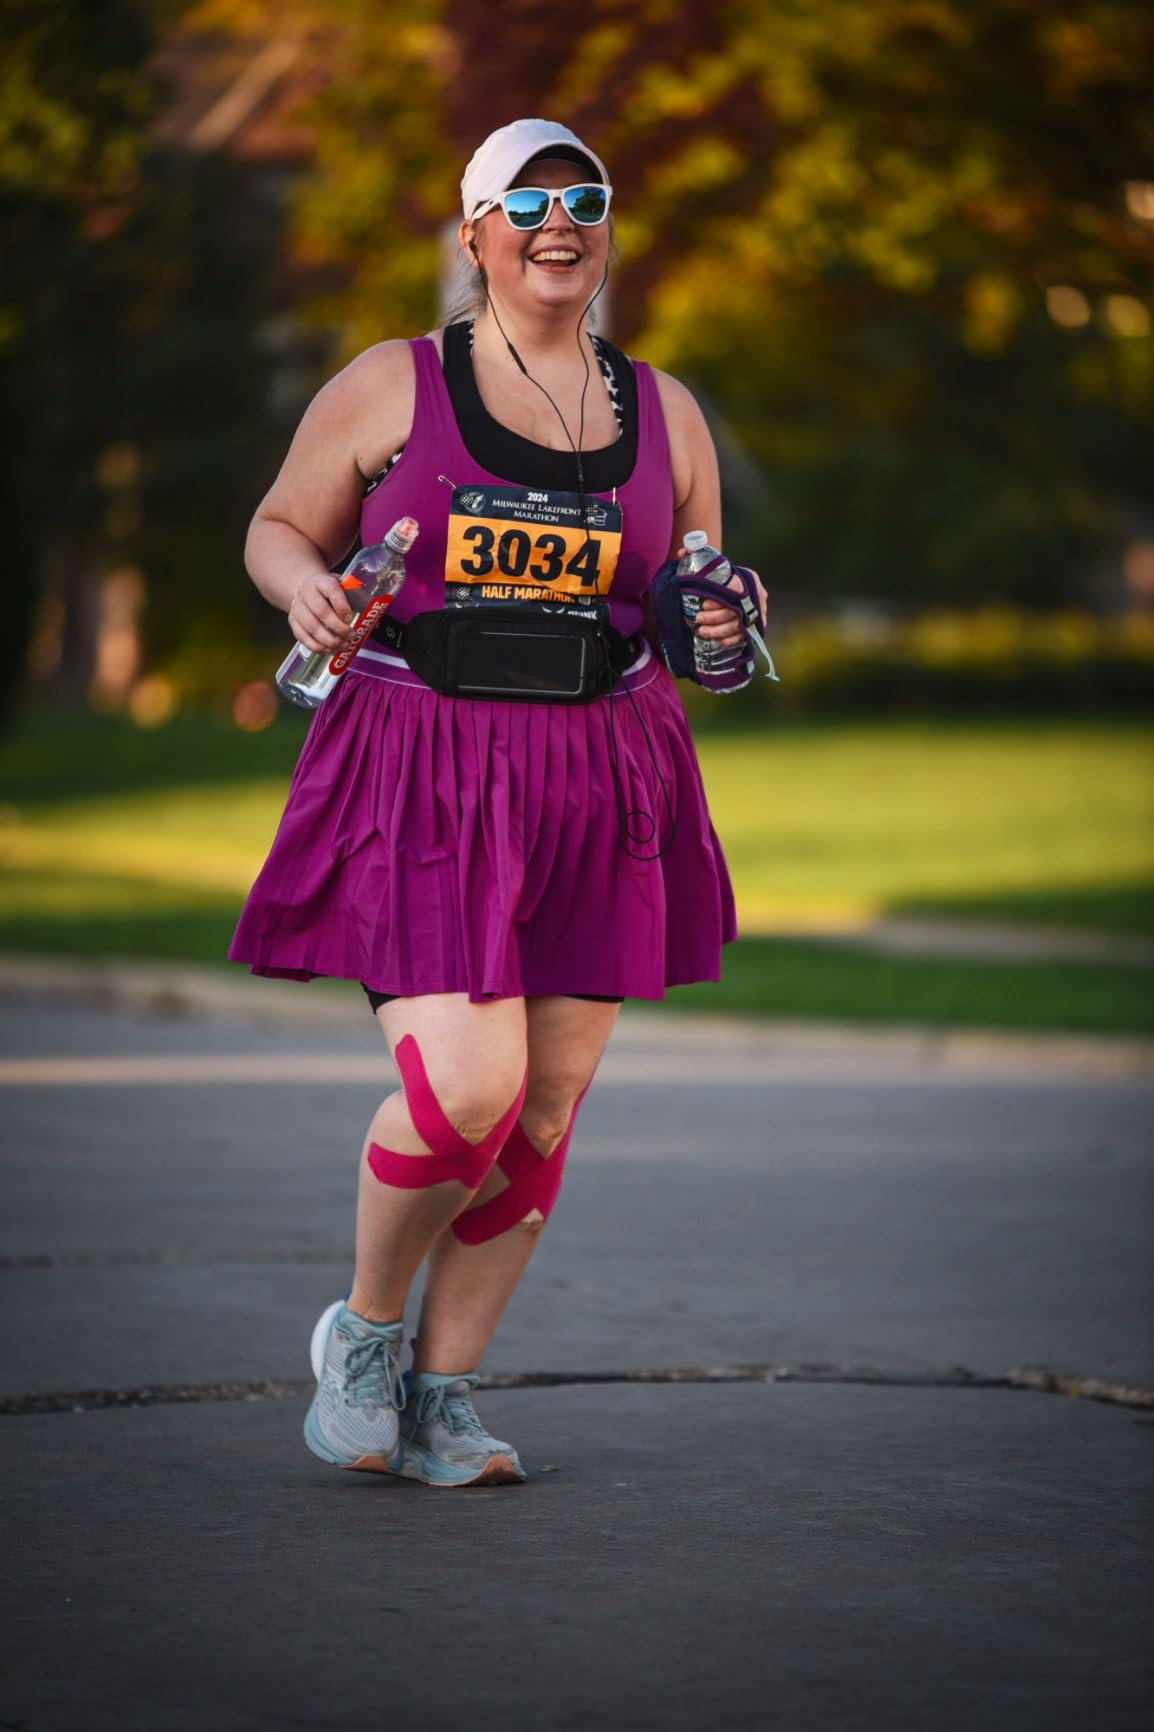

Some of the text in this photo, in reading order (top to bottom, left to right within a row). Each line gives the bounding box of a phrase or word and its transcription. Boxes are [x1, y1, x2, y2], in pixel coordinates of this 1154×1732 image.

[527, 492, 549, 502] 2024
[492, 499, 582, 517] MILWAUKEE LAKEFRONT
[514, 510, 560, 523] MARATHON
[460, 525, 601, 587] 3034
[481, 585, 511, 599] HALF
